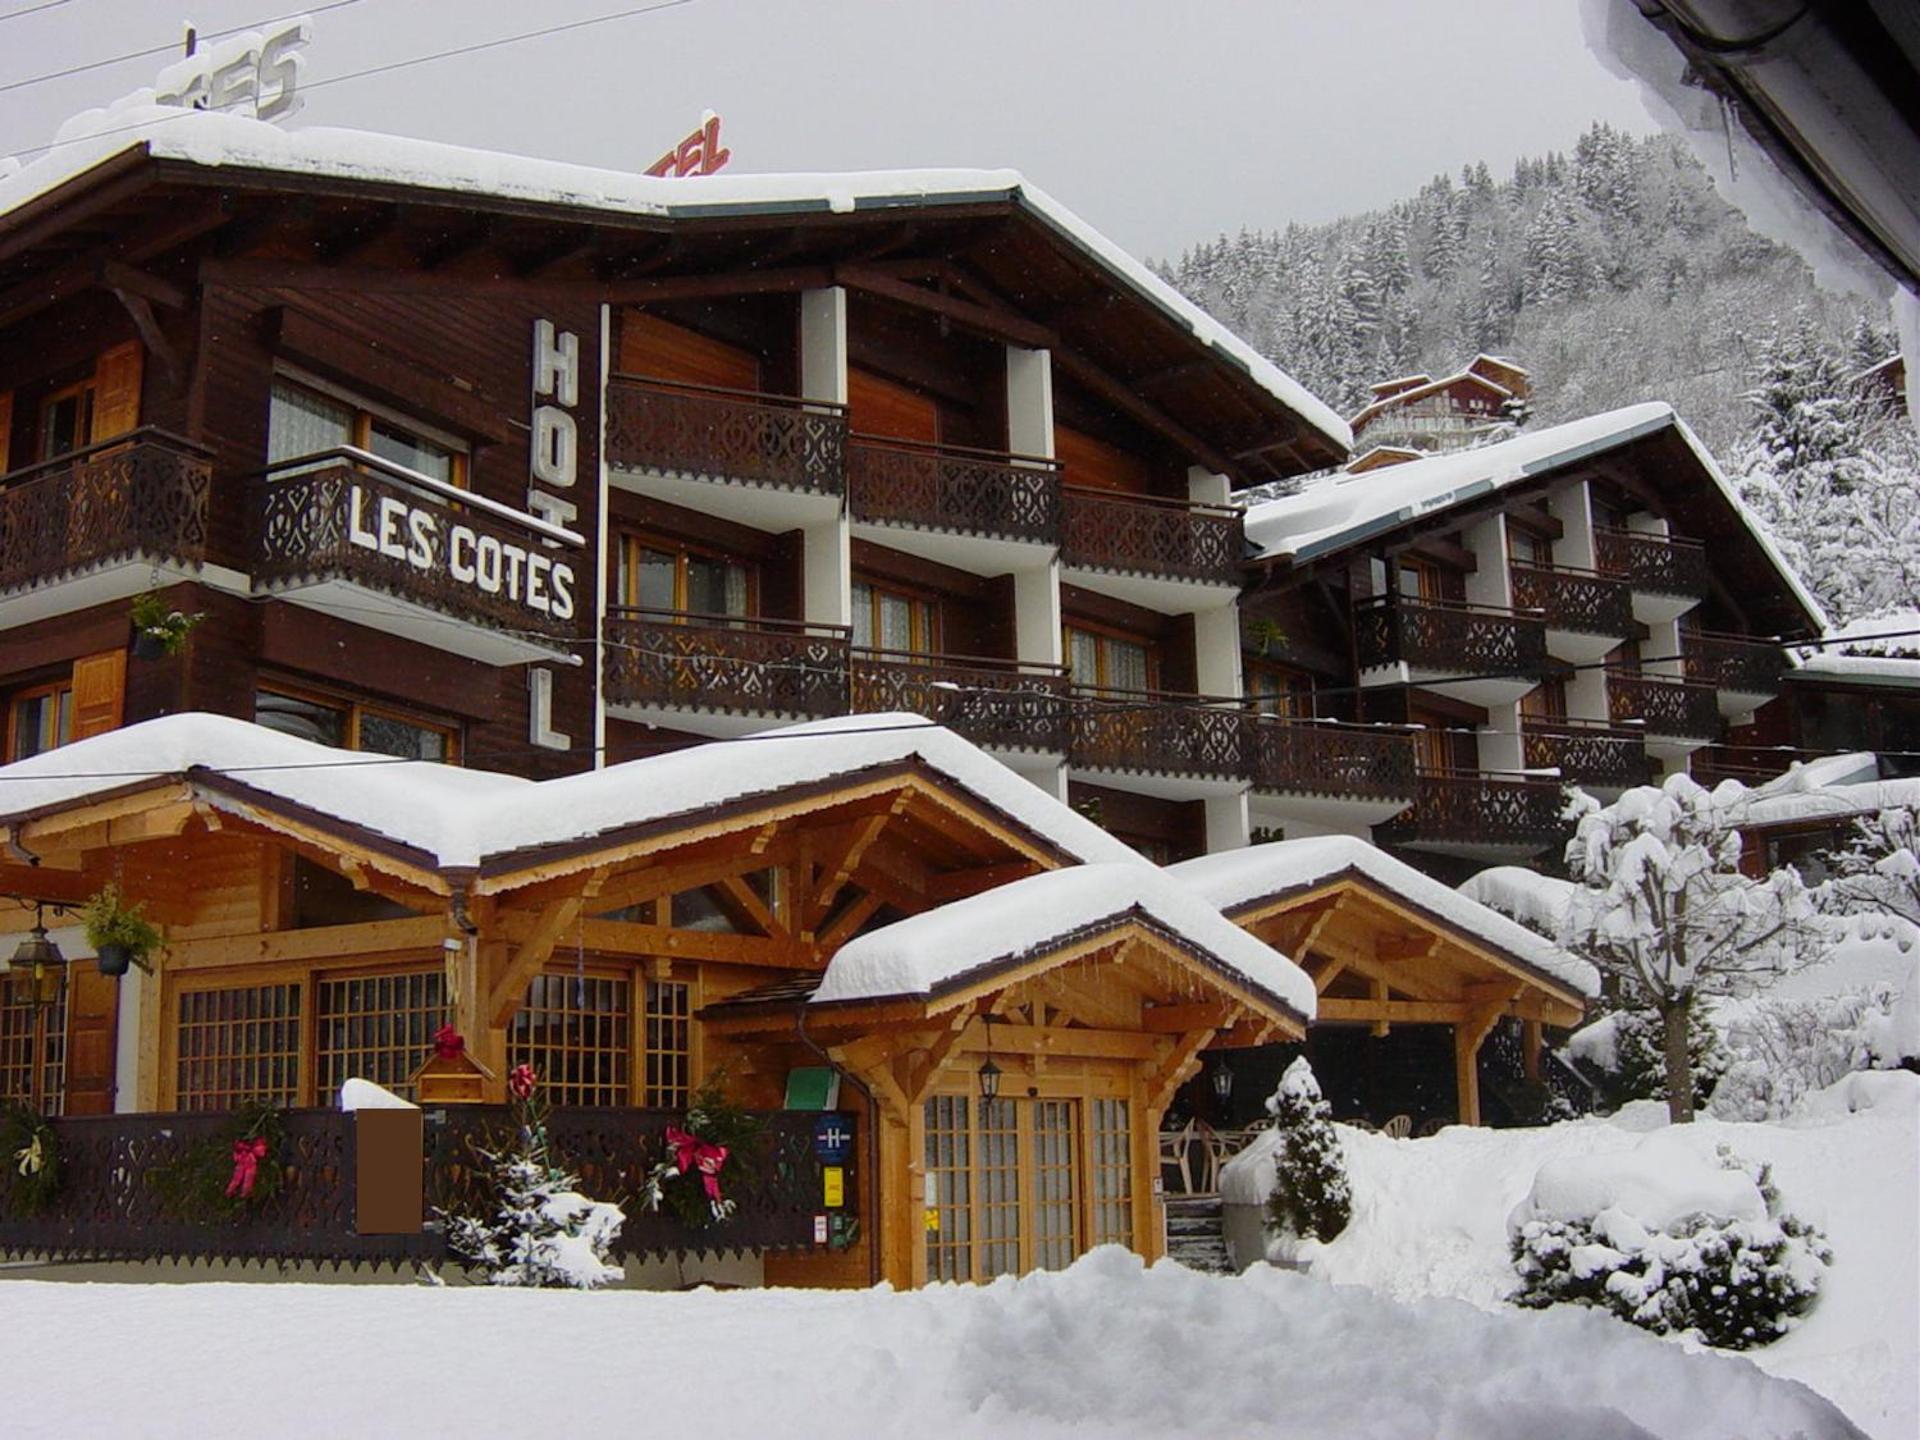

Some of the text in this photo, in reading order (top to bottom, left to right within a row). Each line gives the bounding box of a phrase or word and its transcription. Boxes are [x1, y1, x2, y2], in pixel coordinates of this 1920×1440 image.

[348, 485, 575, 620] LES COTES
[529, 318, 579, 751] HOTL
